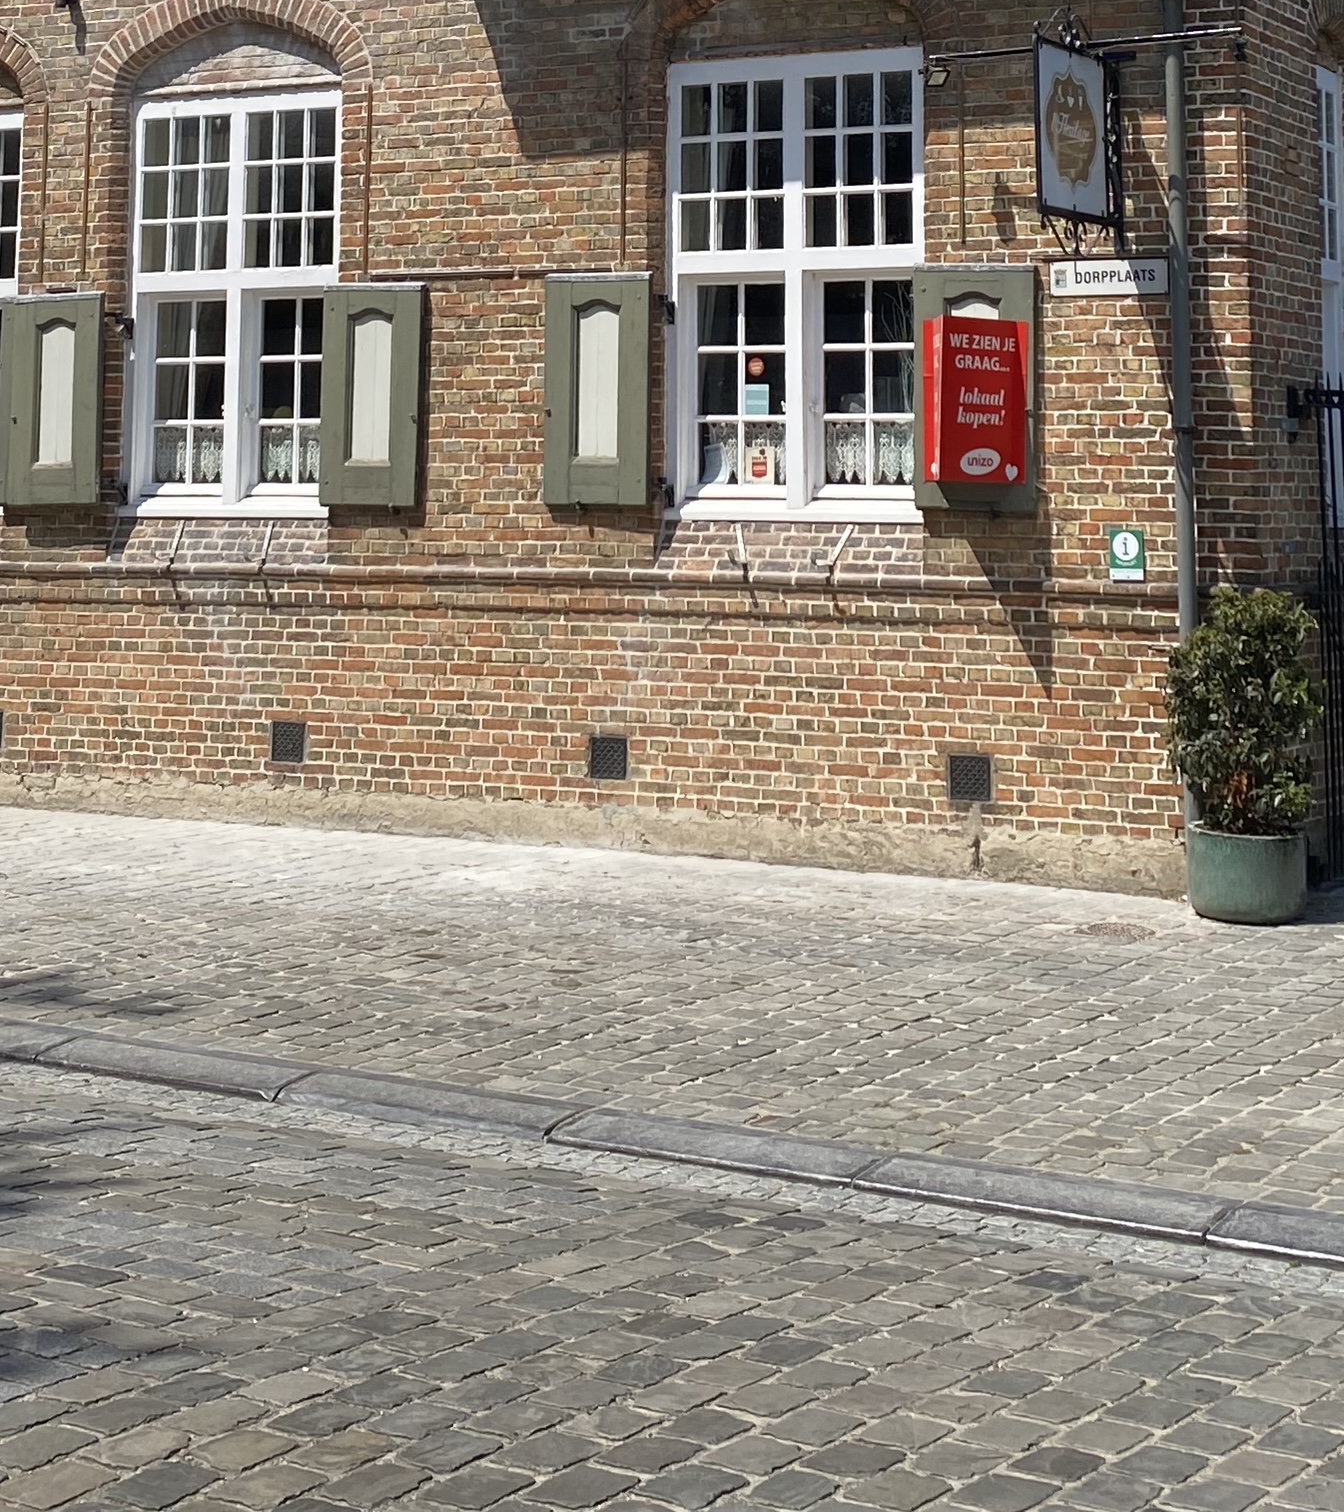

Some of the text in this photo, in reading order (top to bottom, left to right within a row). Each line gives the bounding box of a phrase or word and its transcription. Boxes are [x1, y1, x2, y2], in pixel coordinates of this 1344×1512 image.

[1075, 269, 1155, 284] DORPPLAATS
[950, 333, 1016, 352] WE ZIEN JE
[955, 354, 1010, 372] GRAAG...
[959, 386, 1005, 407] lokaal
[957, 406, 1006, 429] kopen!
[967, 454, 994, 467] unizo
